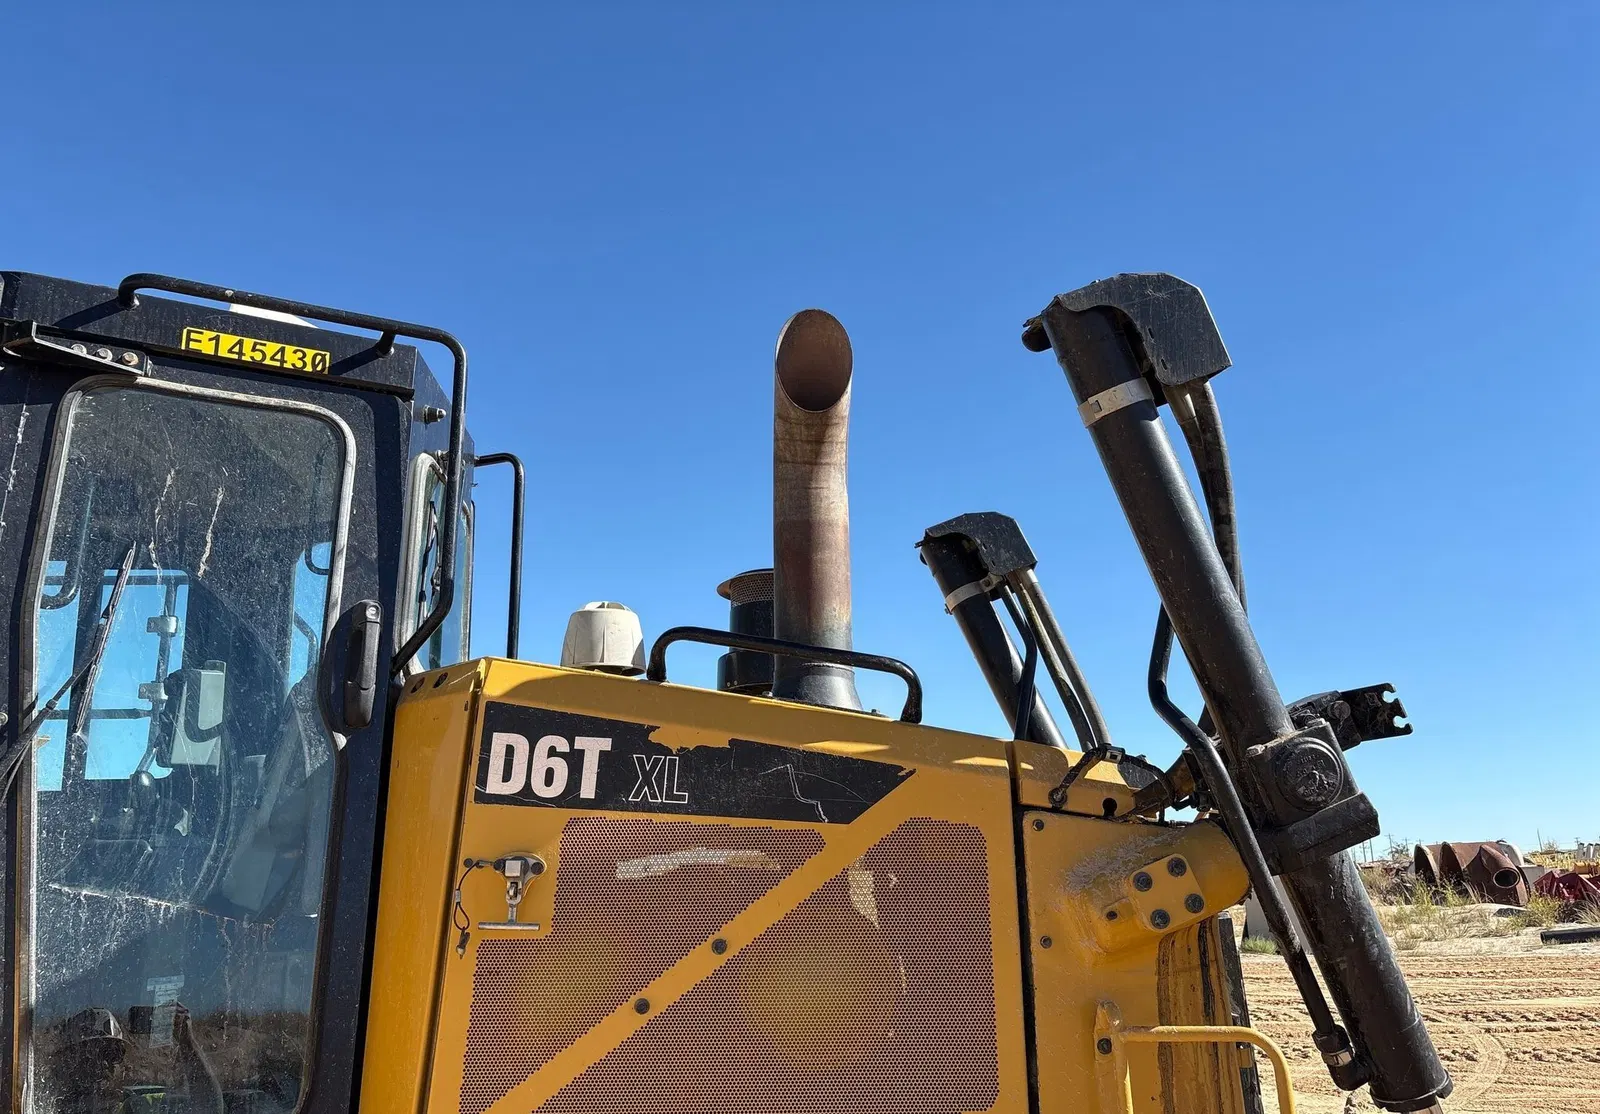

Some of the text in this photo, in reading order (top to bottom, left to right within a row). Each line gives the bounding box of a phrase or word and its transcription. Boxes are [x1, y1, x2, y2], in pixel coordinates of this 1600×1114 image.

[184, 329, 328, 374] E145430
[486, 732, 689, 804] D6T XL
